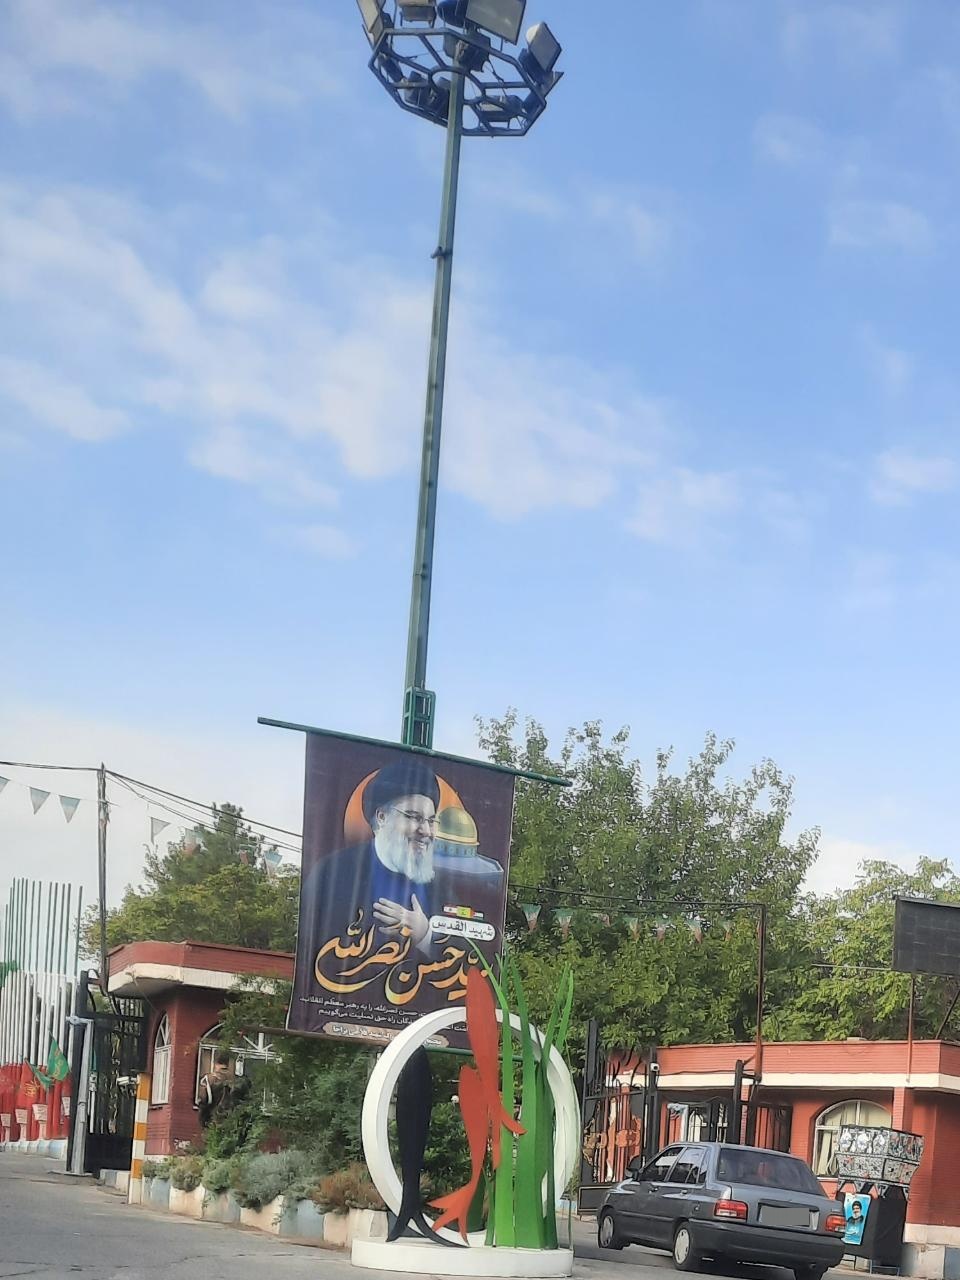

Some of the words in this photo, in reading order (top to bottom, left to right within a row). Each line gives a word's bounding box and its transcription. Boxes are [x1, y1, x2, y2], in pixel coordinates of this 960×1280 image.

[432, 920, 467, 932] القدس
[468, 925, 494, 938] شهید
[385, 934, 466, 1005] حسن
[349, 1012, 374, 1020] تسلیت
